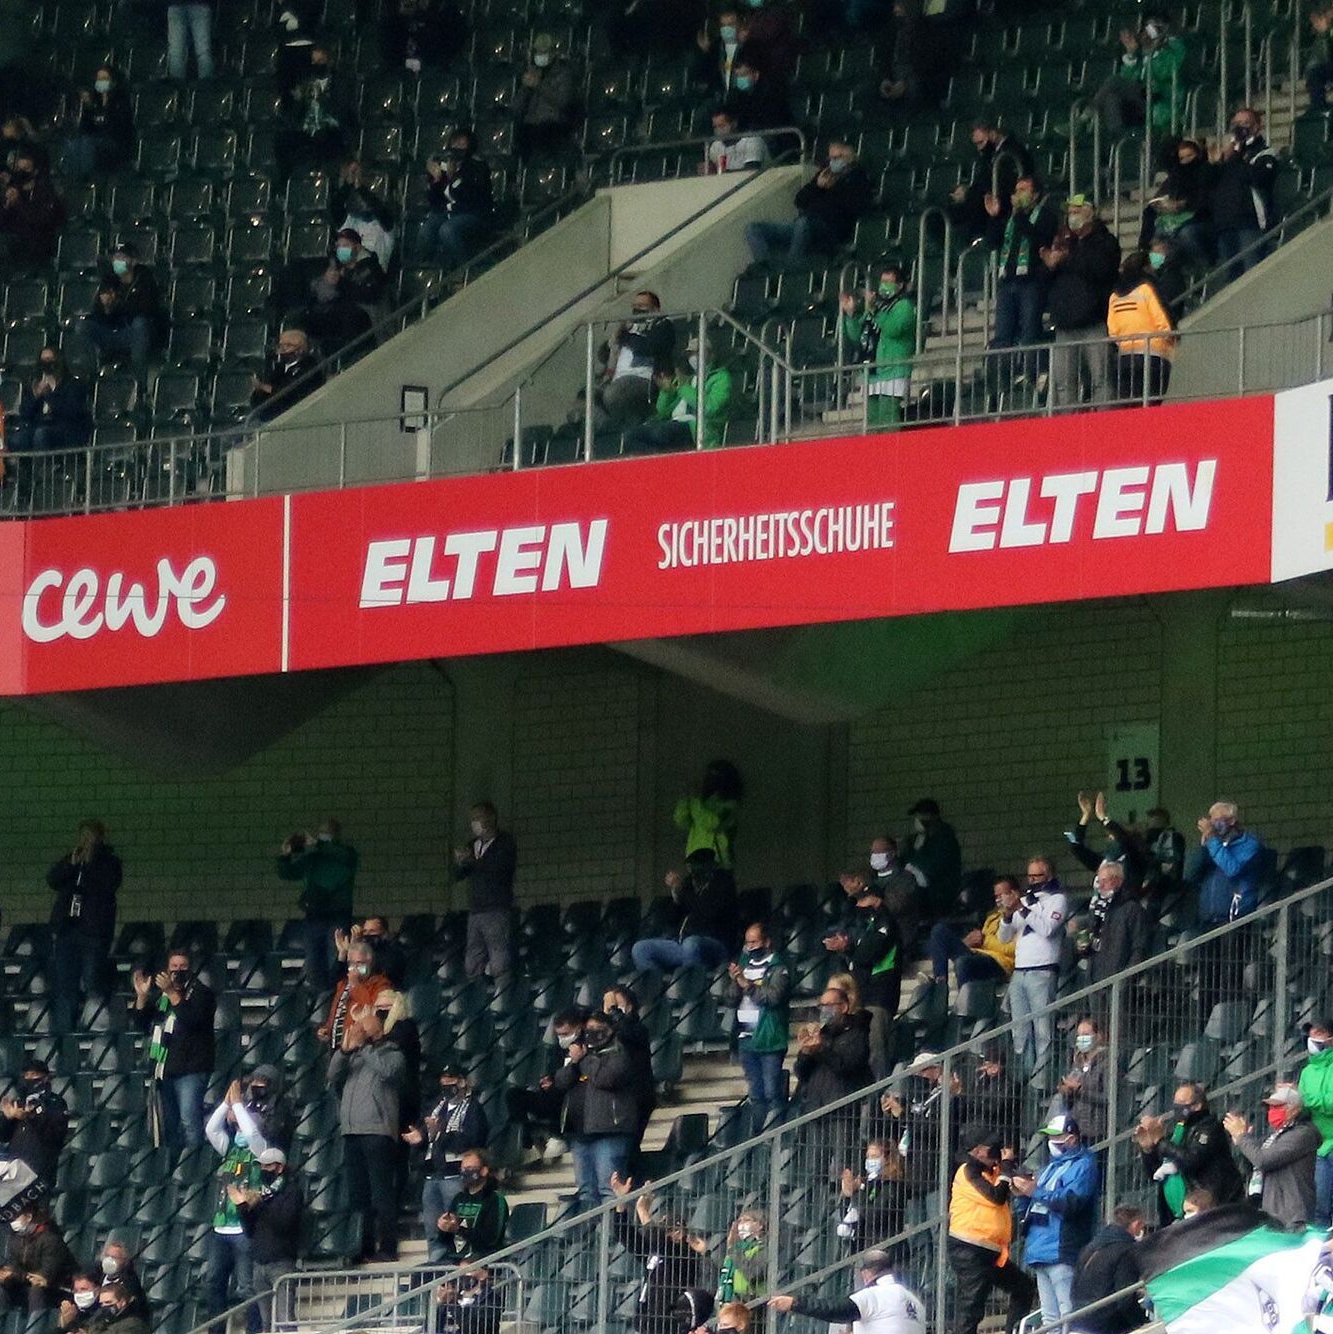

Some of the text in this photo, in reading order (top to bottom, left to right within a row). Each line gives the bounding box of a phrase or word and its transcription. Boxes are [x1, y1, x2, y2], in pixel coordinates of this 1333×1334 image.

[358, 460, 1217, 609] ELTEN SICHERHEITSSCHUHE ELTEN
[21, 556, 225, 643] cewe
[1116, 758, 1152, 791] 13
